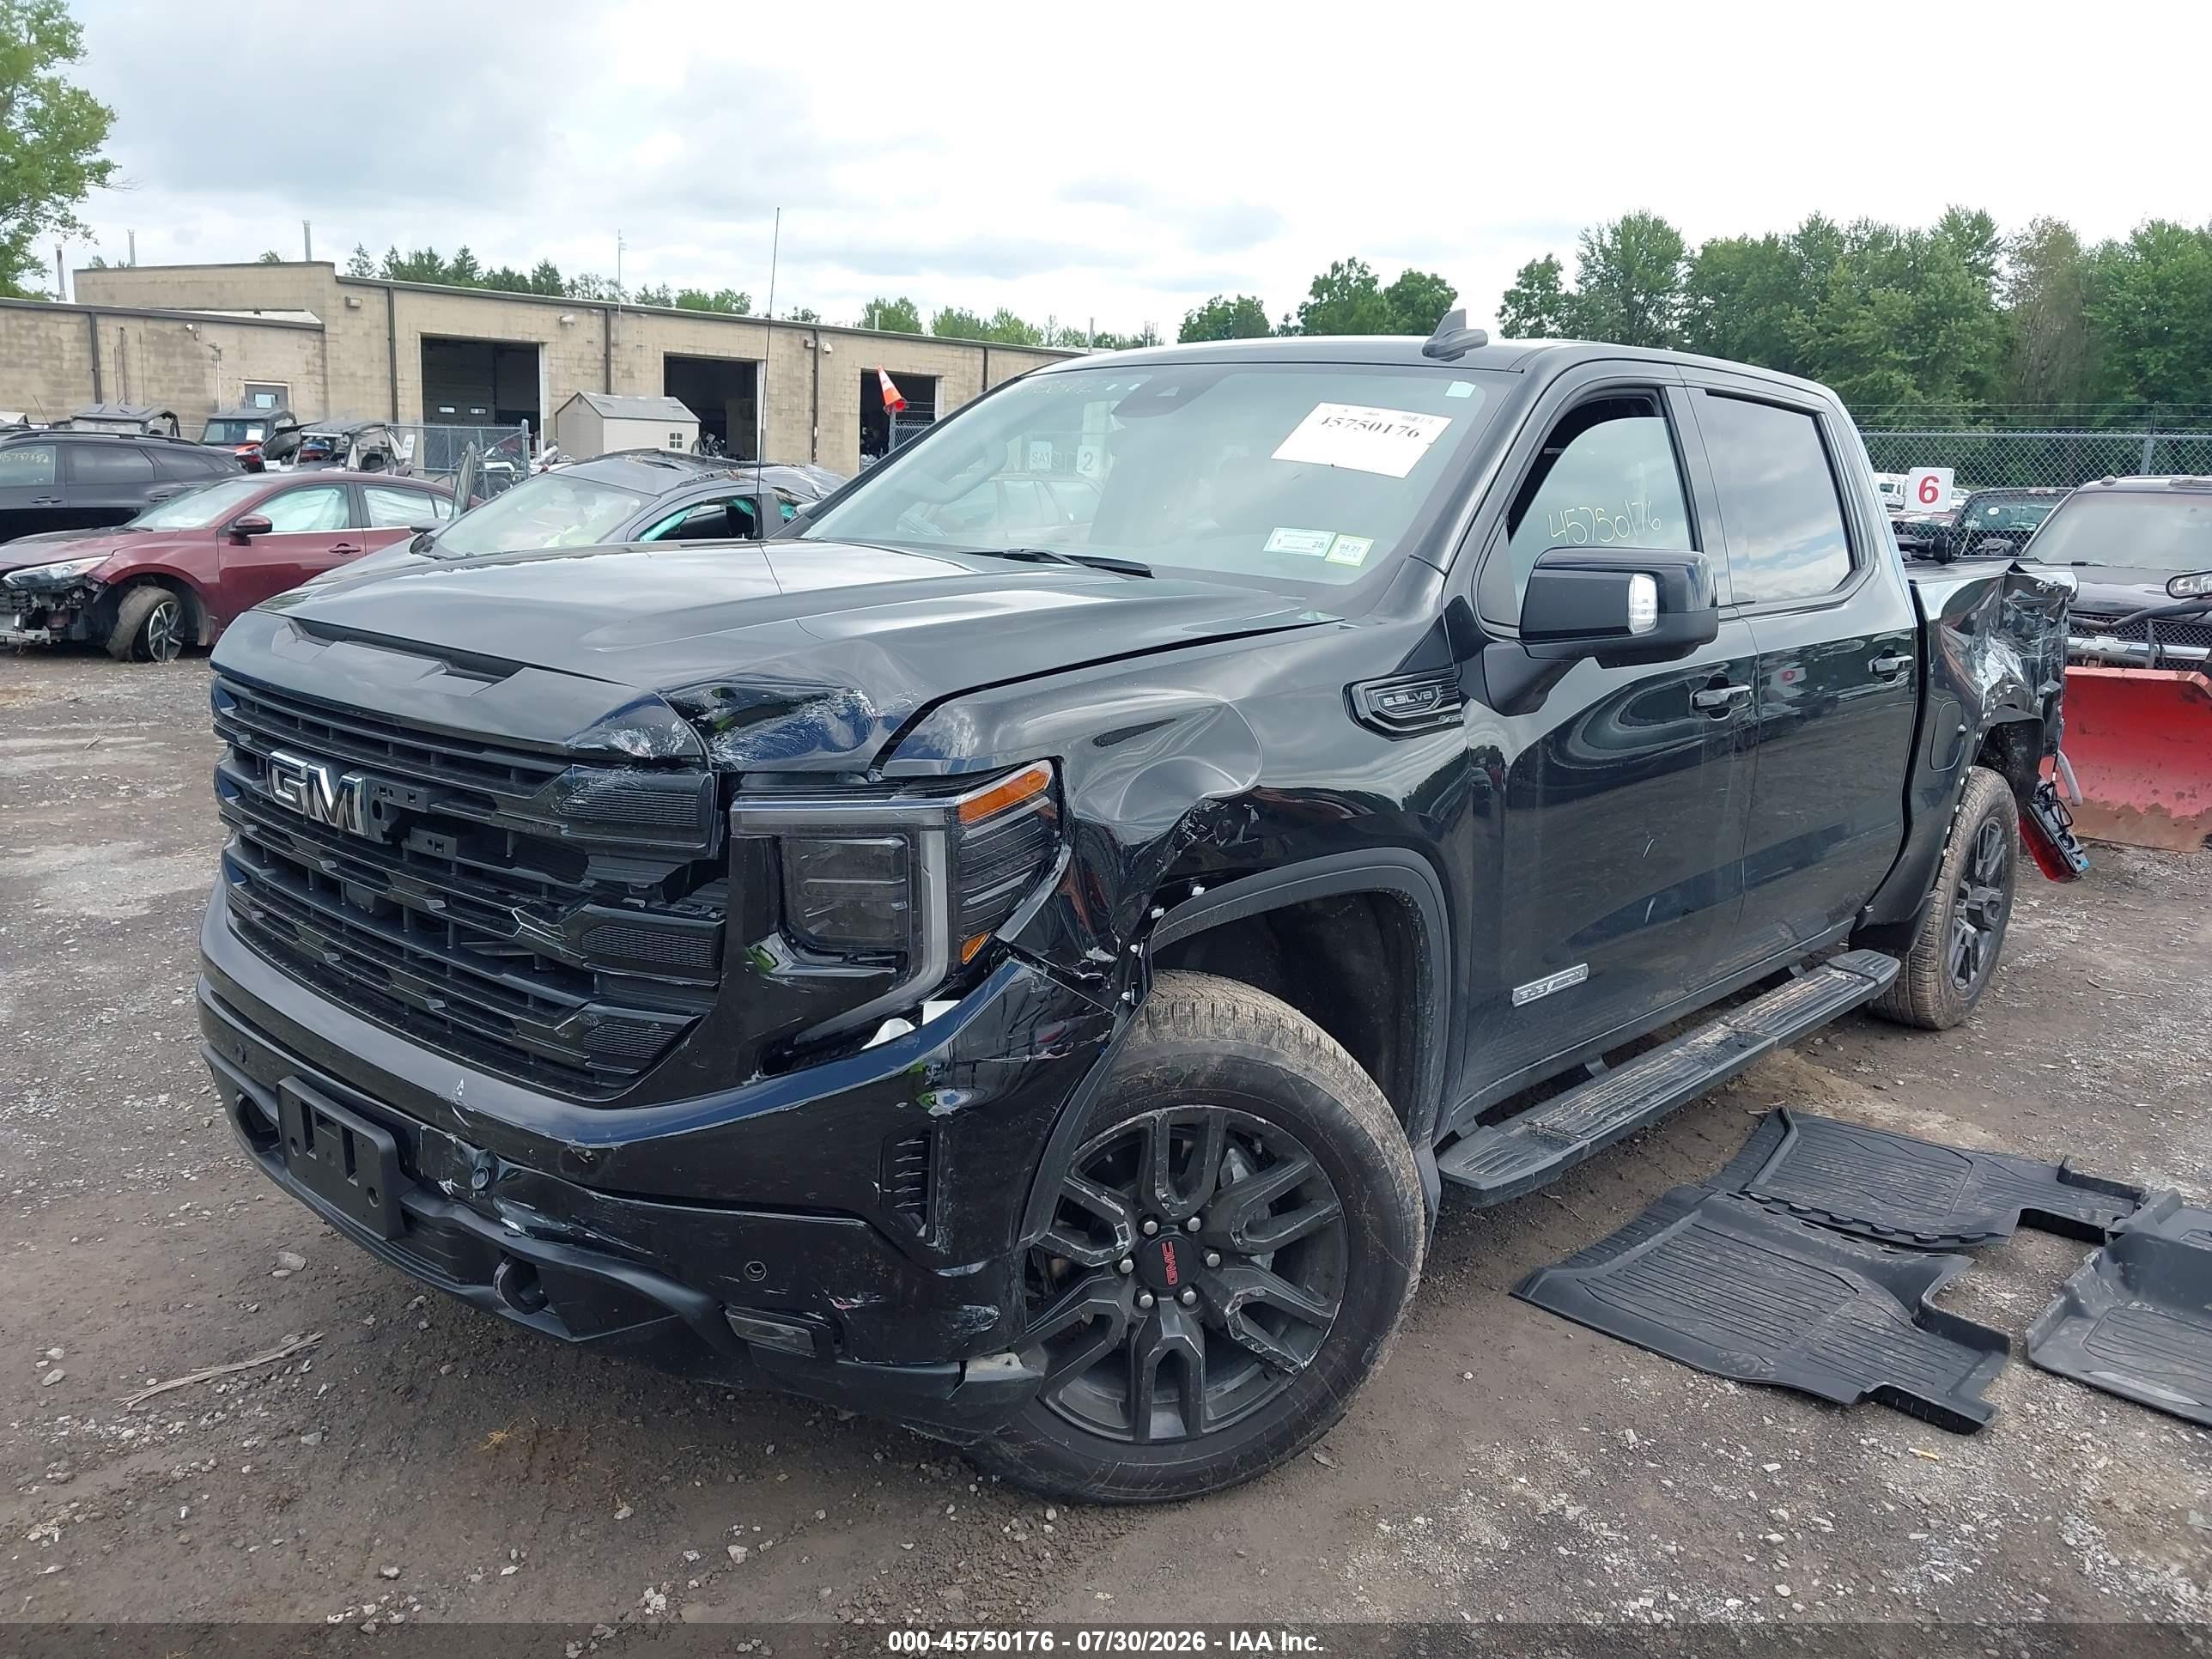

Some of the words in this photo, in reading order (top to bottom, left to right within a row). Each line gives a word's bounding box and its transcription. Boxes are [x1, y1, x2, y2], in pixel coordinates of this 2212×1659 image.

[1918, 475, 1940, 504] 6
[1548, 500, 1662, 545] 45750176
[1161, 1241, 1179, 1285] GMC
